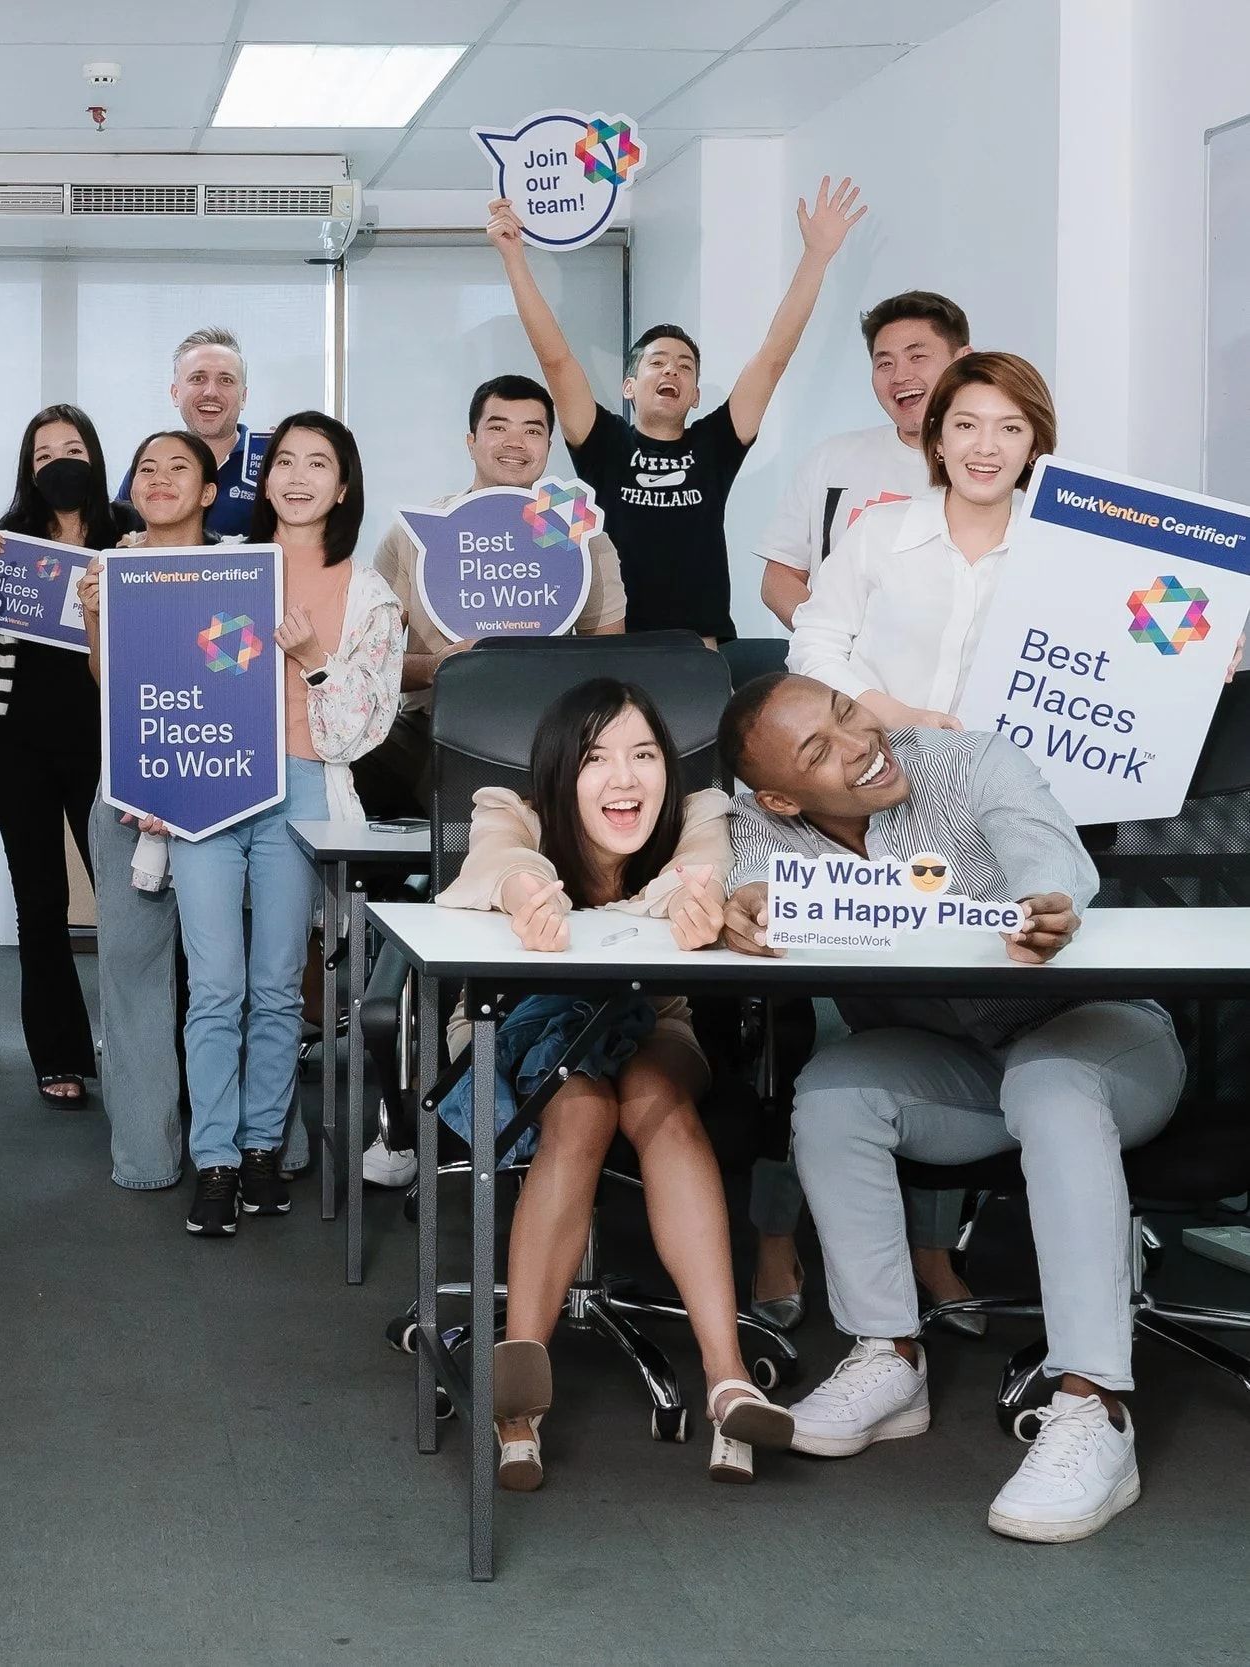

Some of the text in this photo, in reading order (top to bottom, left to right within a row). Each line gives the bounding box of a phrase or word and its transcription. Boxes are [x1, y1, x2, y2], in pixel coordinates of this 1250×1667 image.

[524, 148, 568, 169] Join
[525, 175, 561, 192] our
[526, 193, 585, 215] team!
[620, 486, 703, 508] THAILAND
[1055, 487, 1160, 528] WorkVenture
[458, 530, 515, 554] Best
[120, 571, 200, 584] WorkVenture
[459, 557, 542, 581] Places
[458, 588, 486, 609] to
[475, 620, 541, 631] WorkVenture
[1019, 628, 1111, 682] Best
[139, 683, 204, 711] Best
[1006, 669, 1137, 734] Places
[140, 717, 234, 745] Places
[995, 713, 1034, 749] to
[138, 752, 169, 779] to
[775, 859, 902, 890] My Work
[774, 896, 1018, 930] is a Happy Place
[772, 932, 892, 948] #BestPlacestoWork
